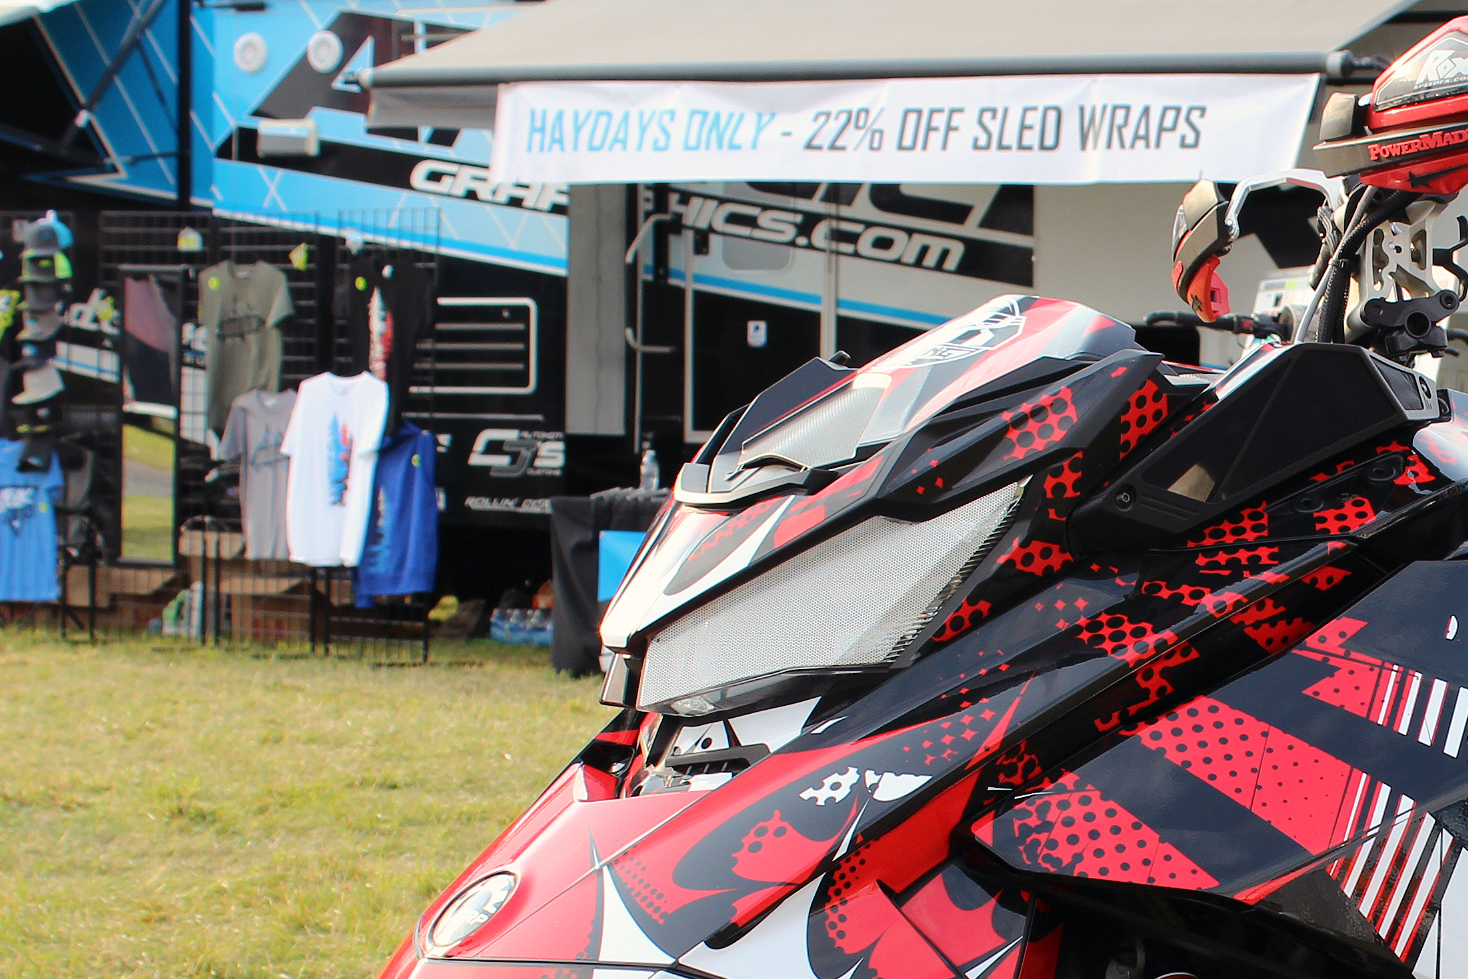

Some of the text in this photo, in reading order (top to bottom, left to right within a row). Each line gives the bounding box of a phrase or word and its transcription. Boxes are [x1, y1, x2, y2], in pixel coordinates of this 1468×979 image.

[527, 108, 675, 153] HAYDAYS
[683, 110, 778, 153] ONLY
[803, 108, 885, 152] 22%
[896, 107, 965, 151] OFF
[972, 106, 1062, 151] SLED
[1077, 104, 1207, 151] WRAPS
